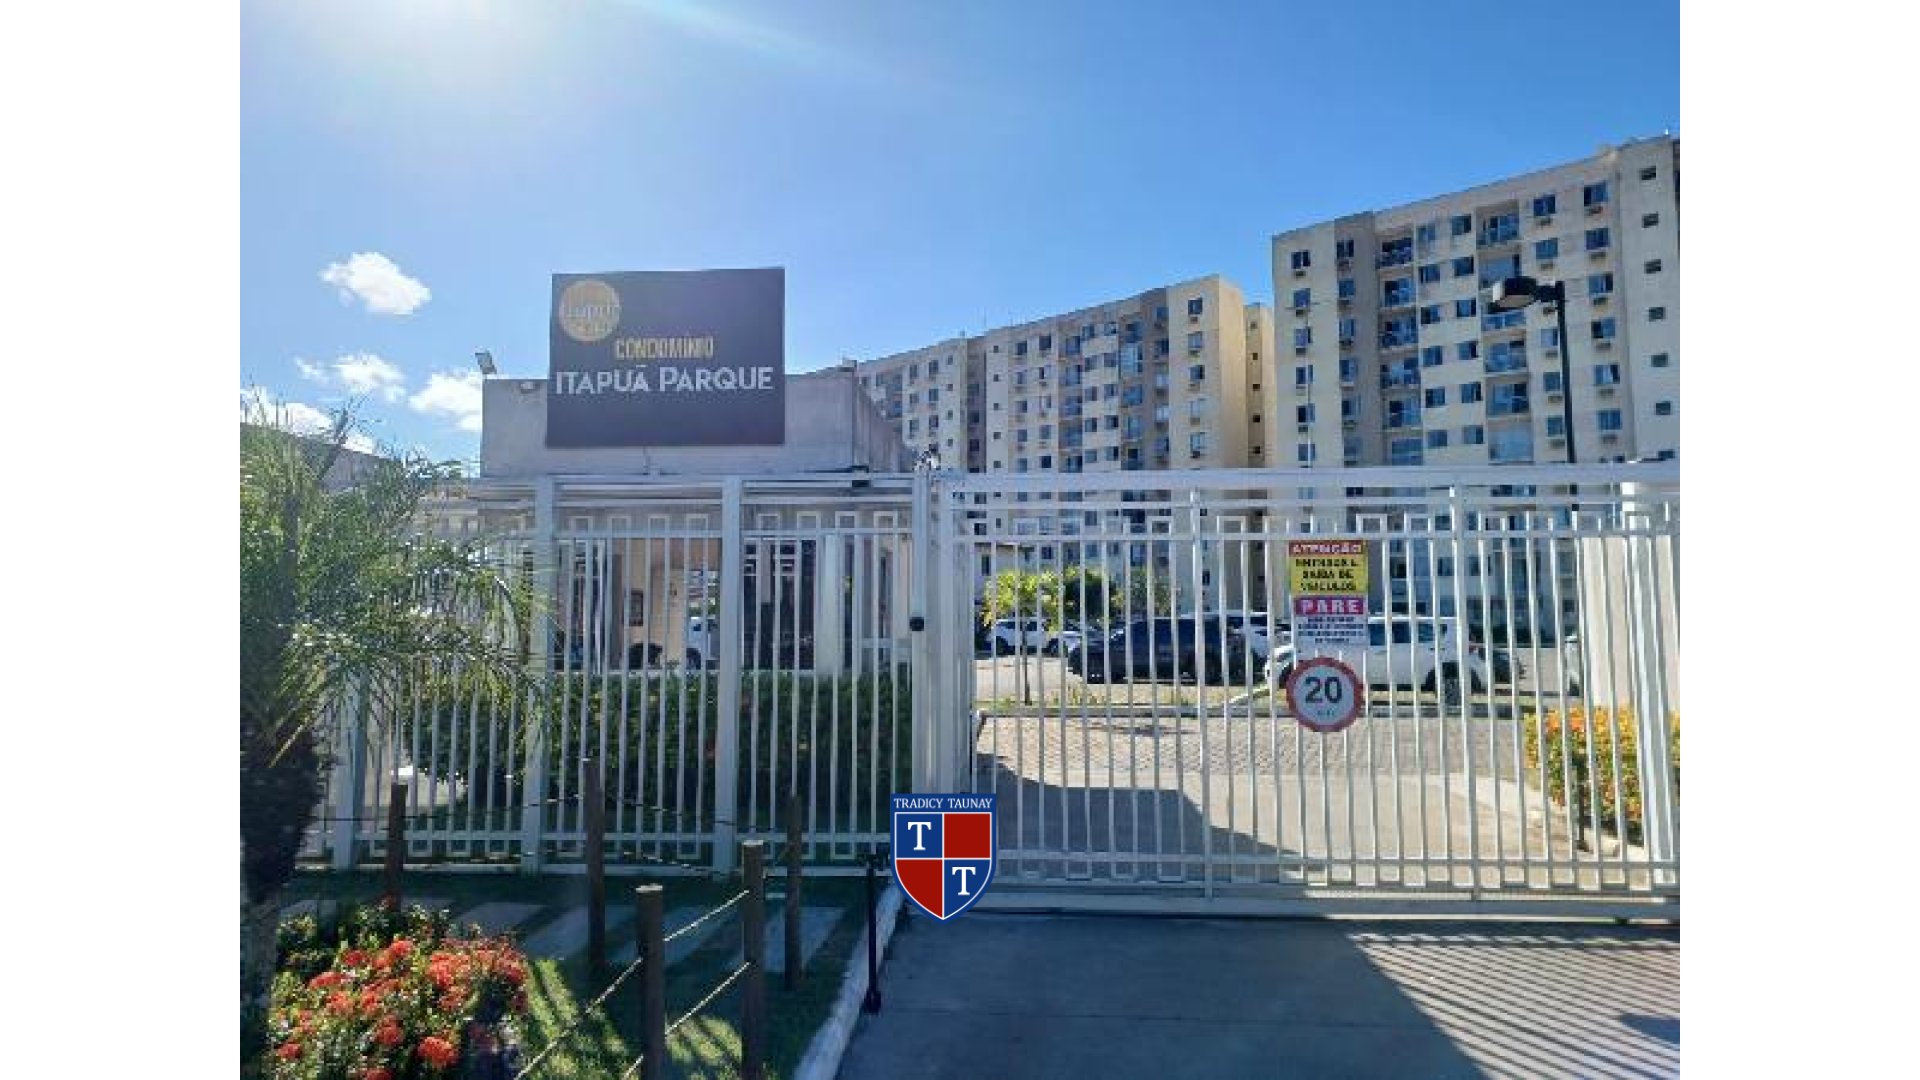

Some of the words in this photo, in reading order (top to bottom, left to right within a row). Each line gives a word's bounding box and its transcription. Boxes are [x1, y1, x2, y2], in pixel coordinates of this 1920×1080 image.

[555, 364, 650, 394] ITAPUÃ
[658, 366, 775, 392] PARQUE
[1301, 599, 1360, 614] PARE
[1304, 676, 1343, 704] 20
